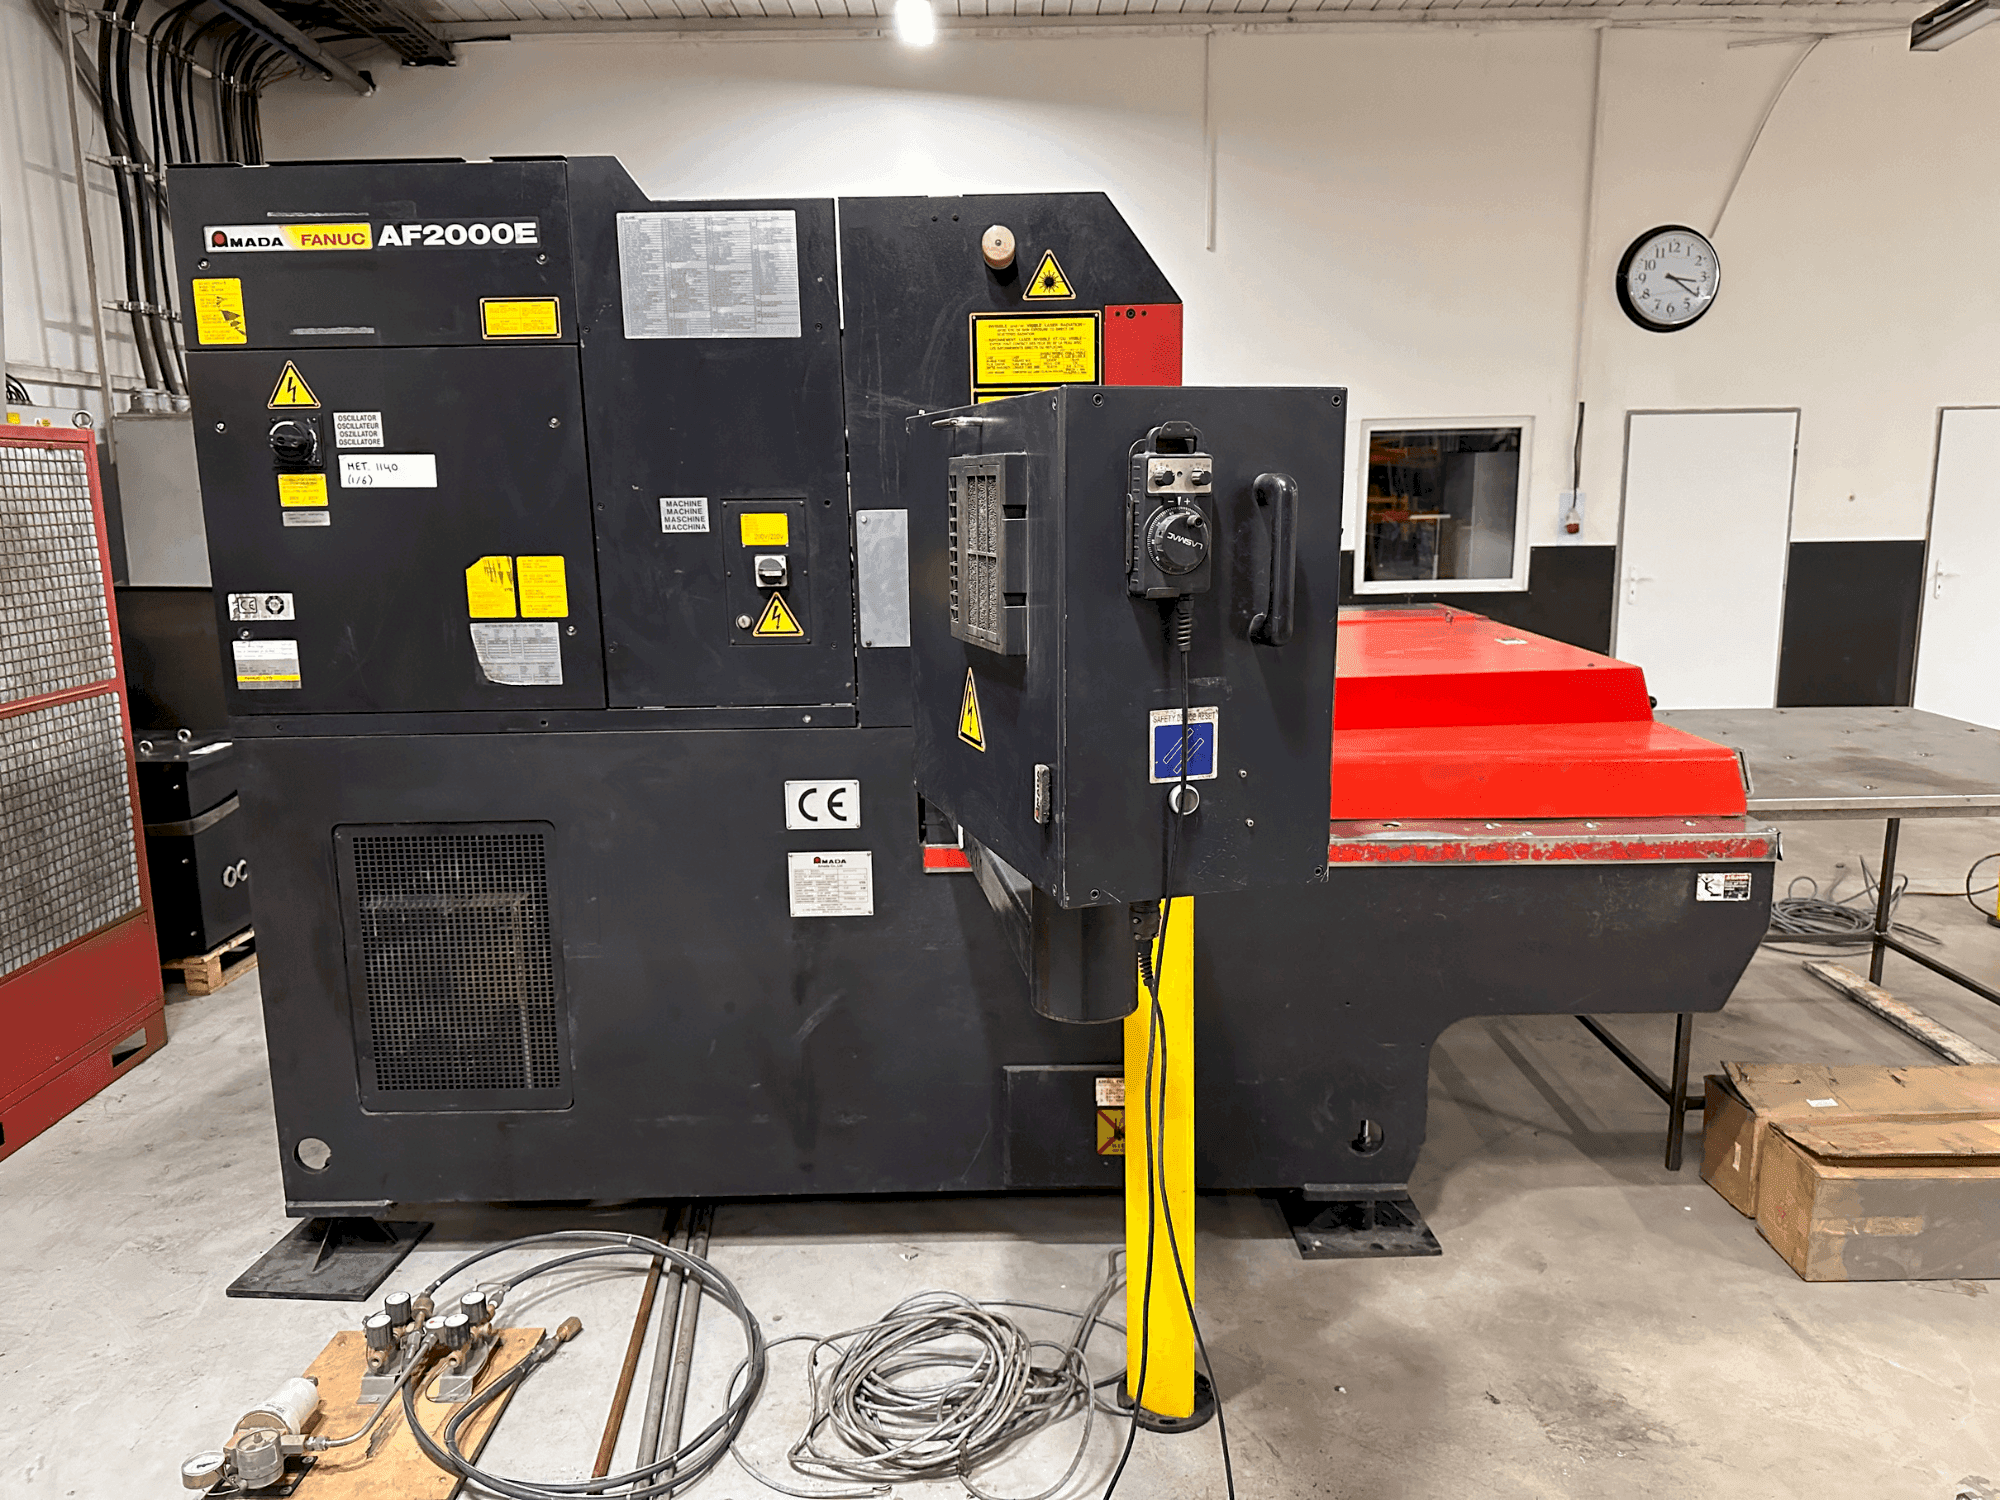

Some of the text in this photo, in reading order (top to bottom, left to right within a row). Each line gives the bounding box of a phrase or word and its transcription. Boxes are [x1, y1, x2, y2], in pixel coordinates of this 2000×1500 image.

[211, 222, 538, 247] AMADA FANUC AF2000E
[1656, 247, 1665, 258] 11
[1668, 242, 1681, 253] 12
[1686, 246, 1690, 257] 1
[1644, 260, 1656, 270] 10
[1695, 256, 1702, 266] 2
[1638, 272, 1647, 284] 9
[1700, 271, 1707, 282] 3
[1642, 288, 1650, 299] 8
[1654, 299, 1661, 310] 7
[1666, 303, 1675, 317] 6
[1683, 298, 1691, 311] 5
[337, 414, 377, 422] OSCILLATOR
[376, 463, 399, 473] 1140
[347, 474, 373, 485] (1/6)
[1166, 532, 1204, 550] LASMAC
[1152, 714, 1176, 723] SAFETY
[1198, 711, 1216, 720] RESET
[798, 788, 847, 822] CE
